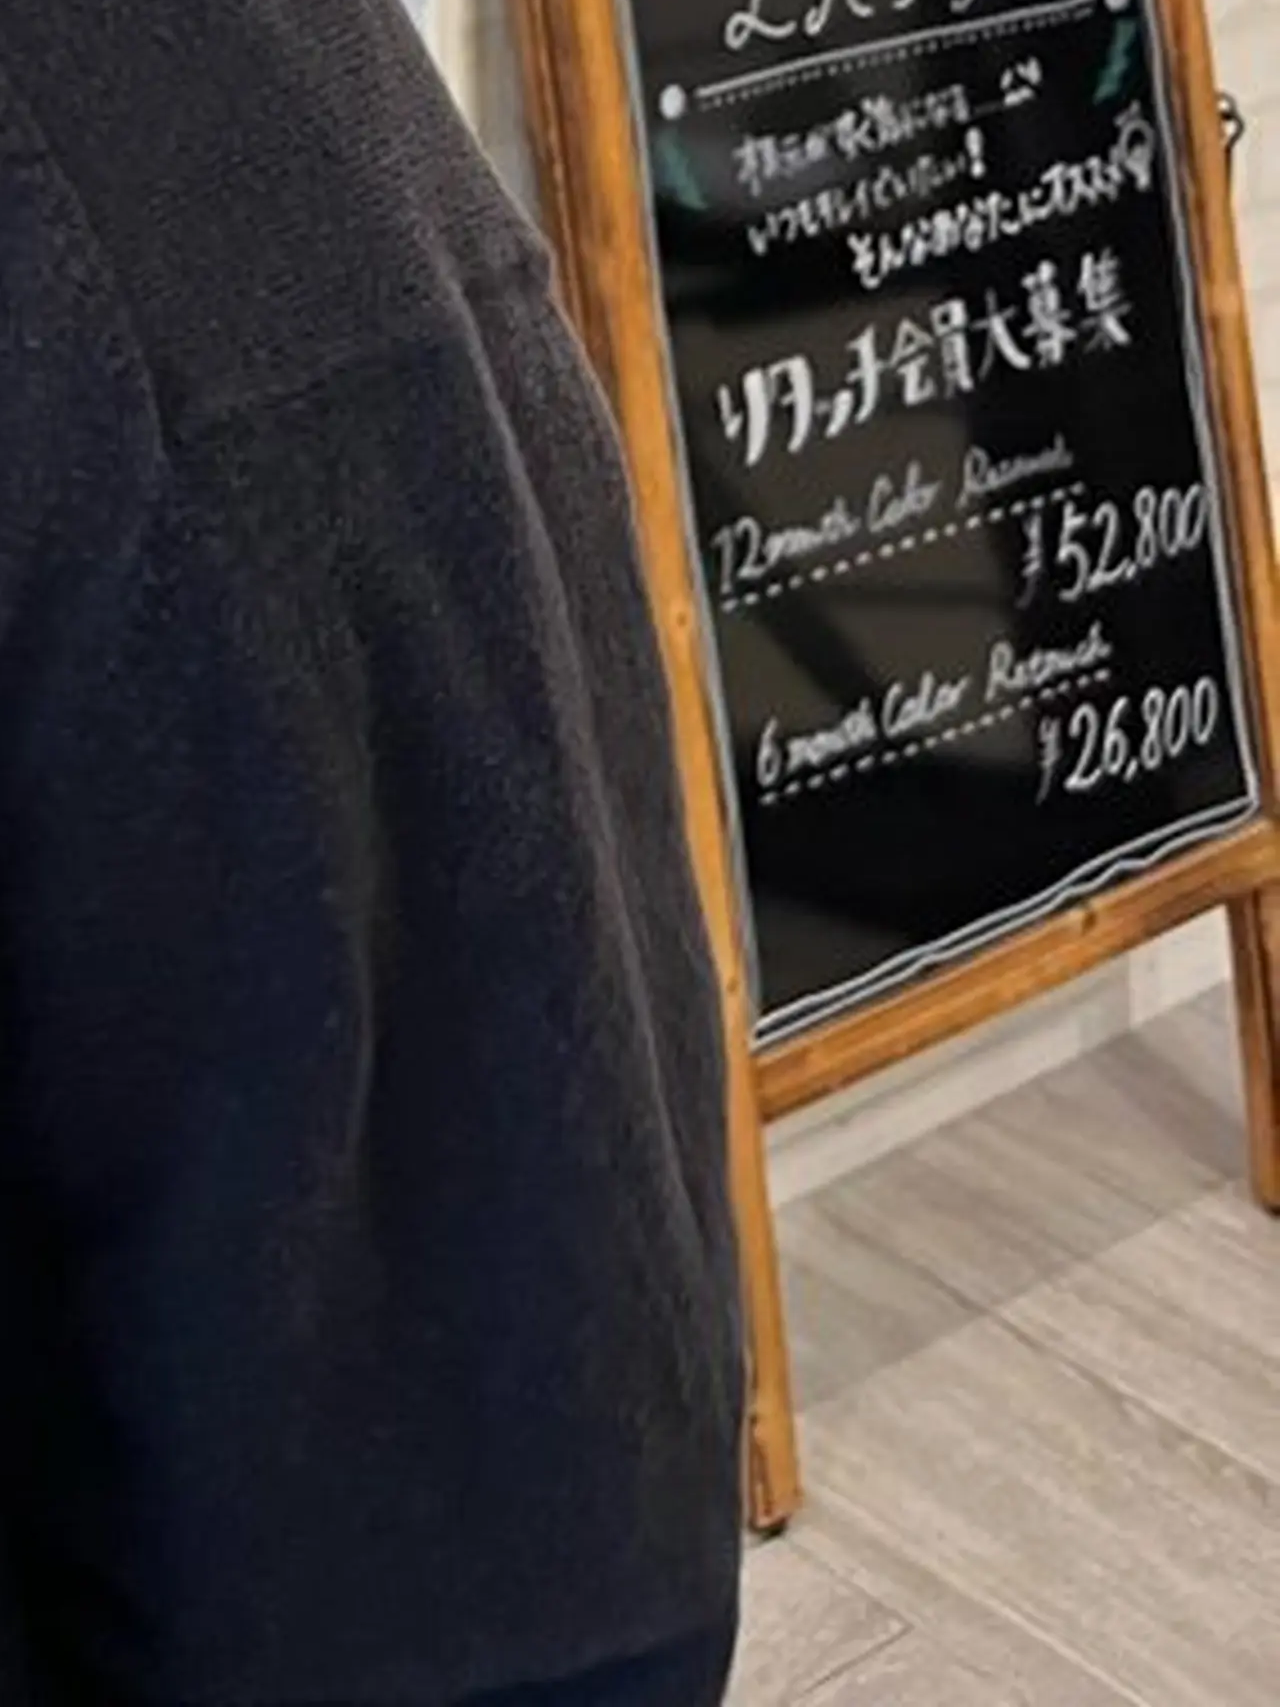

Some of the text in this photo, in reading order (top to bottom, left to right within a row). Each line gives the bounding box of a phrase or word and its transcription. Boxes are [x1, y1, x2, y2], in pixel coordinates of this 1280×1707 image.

[718, 247, 1131, 466] リタッチ会員大募集
[882, 671, 972, 737] Color
